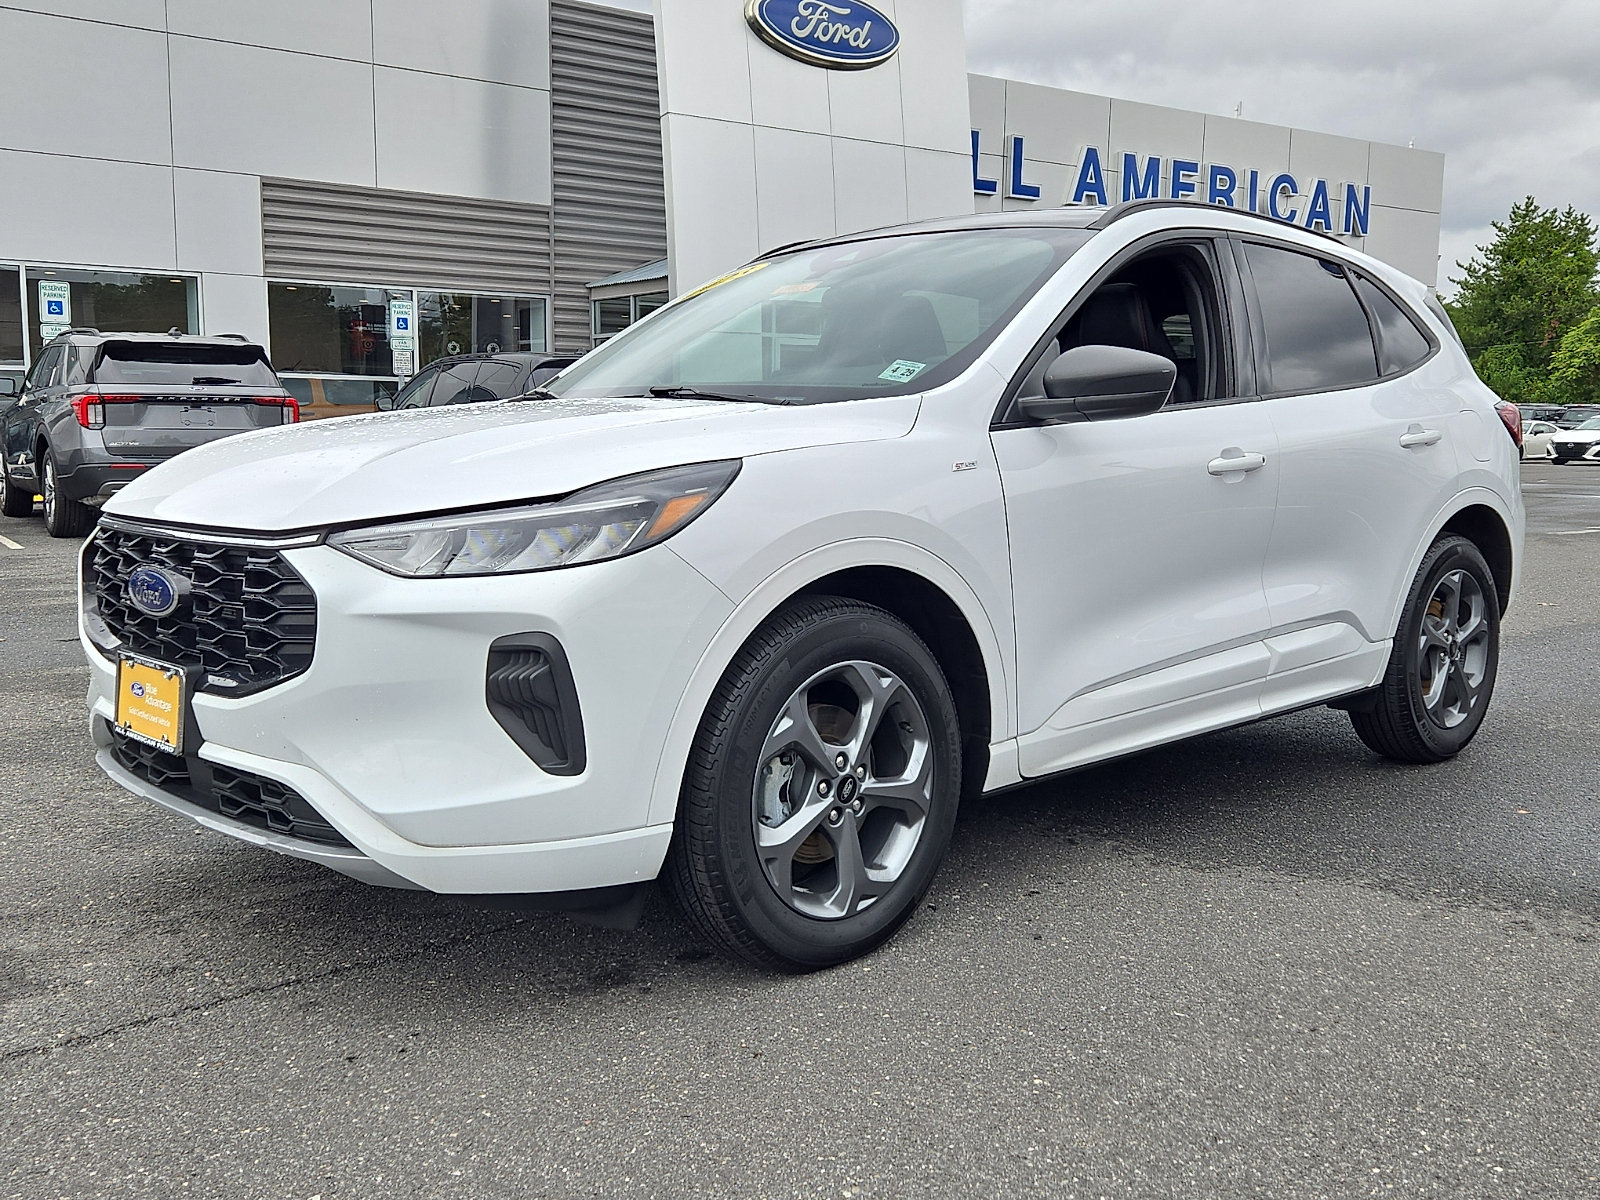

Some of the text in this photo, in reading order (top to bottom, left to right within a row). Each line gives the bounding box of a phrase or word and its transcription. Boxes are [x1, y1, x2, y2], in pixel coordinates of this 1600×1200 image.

[790, 0, 872, 49] Ford
[1072, 145, 1372, 237] AMERICAN
[41, 284, 67, 292] RESERVED
[890, 366, 901, 374] 4
[899, 368, 916, 377] 29
[134, 575, 164, 606] Ford
[145, 683, 158, 695] Blue
[145, 695, 173, 713] Advantage
[115, 727, 175, 753] ALL AMERICAN FORD
